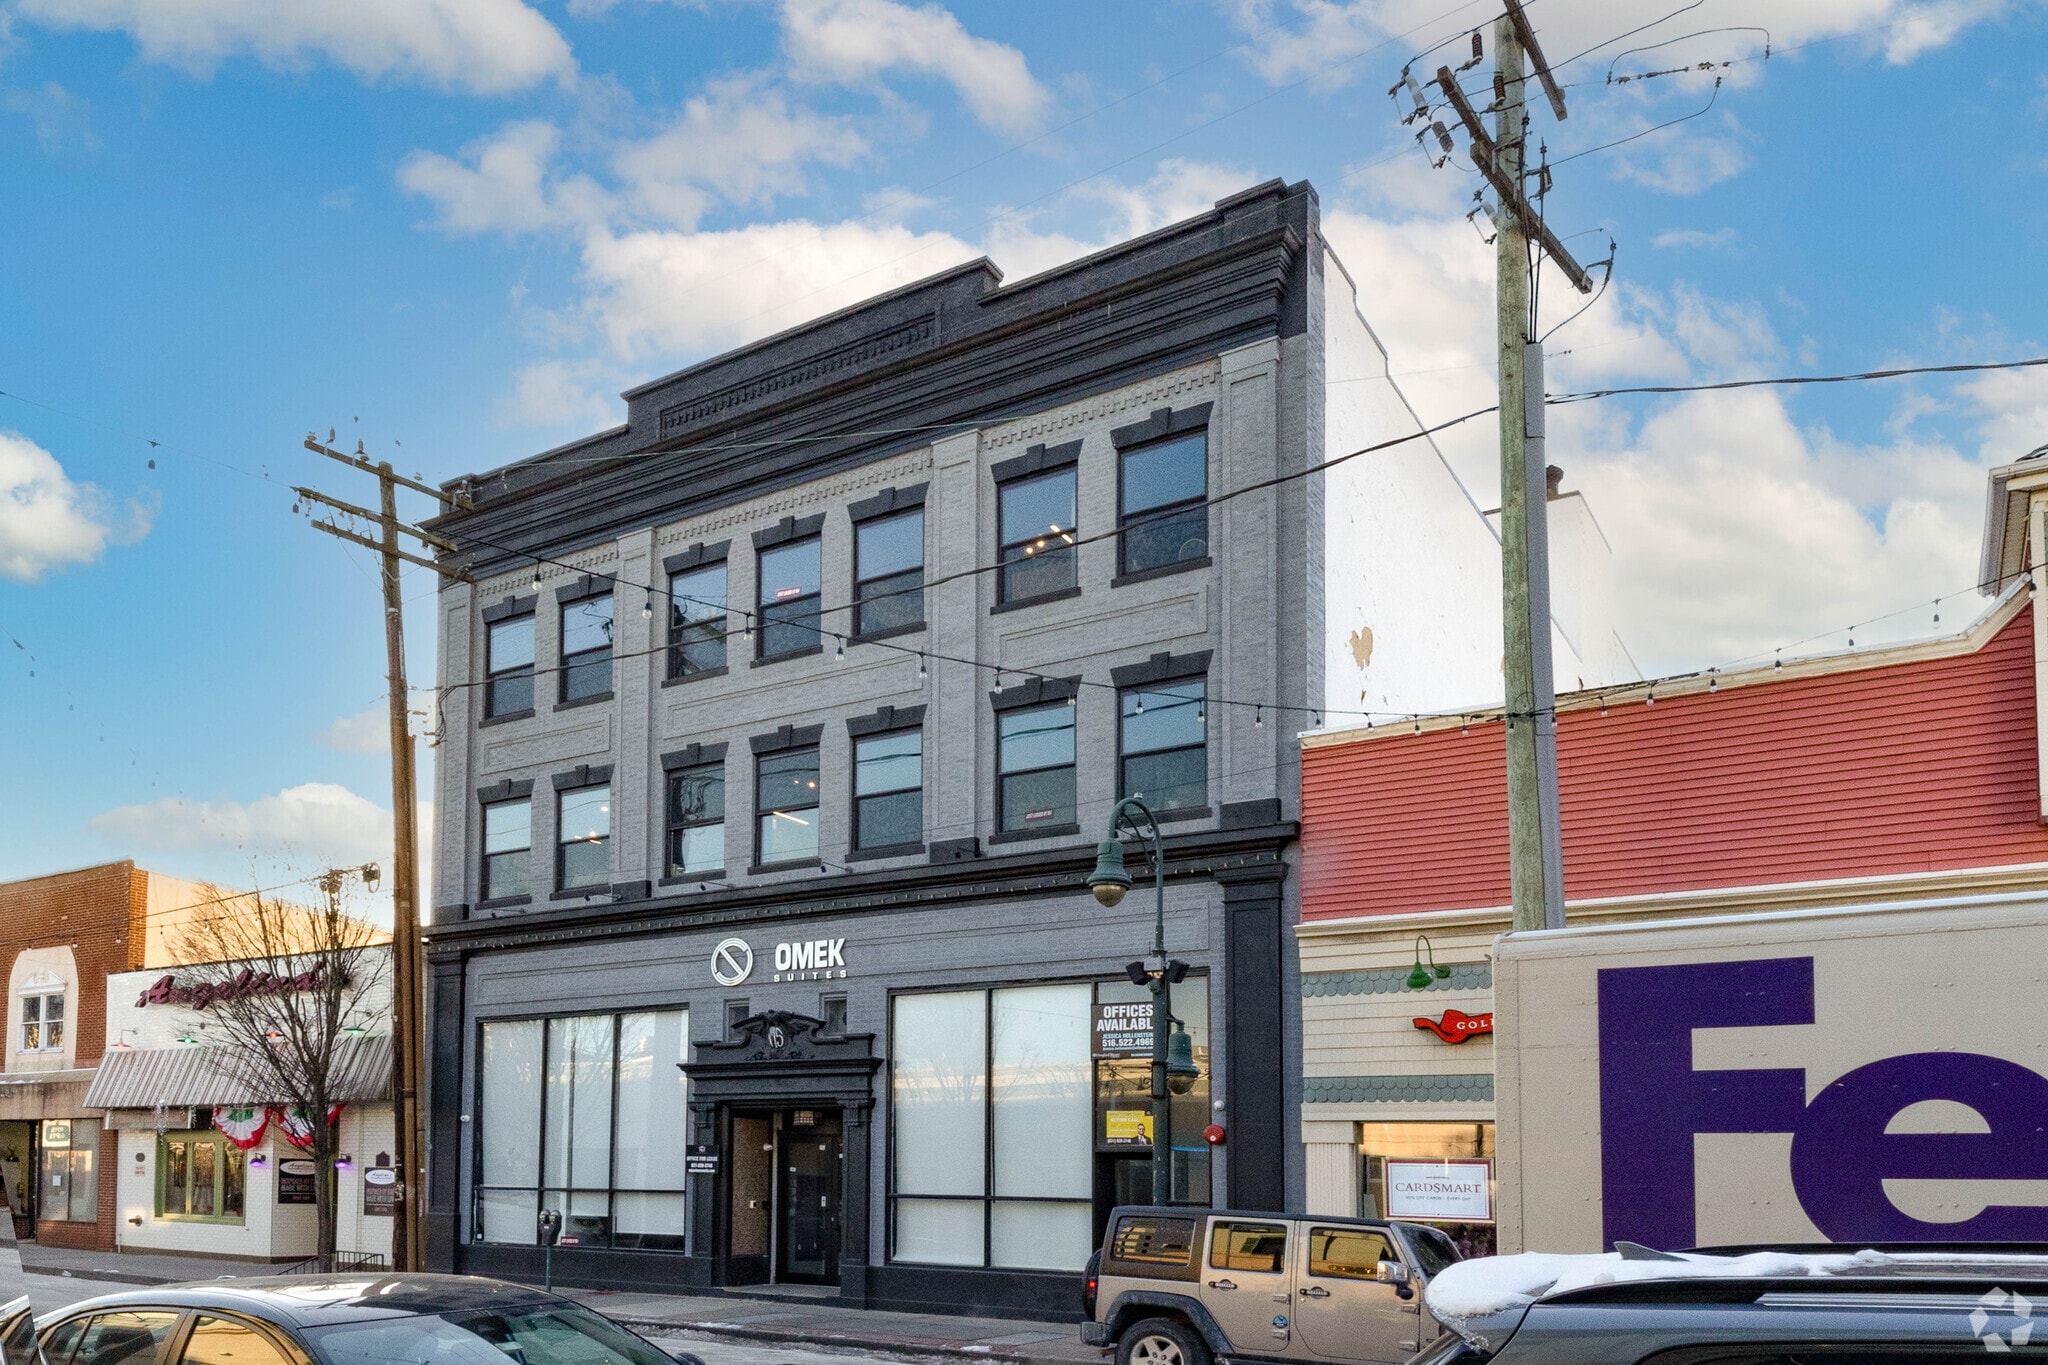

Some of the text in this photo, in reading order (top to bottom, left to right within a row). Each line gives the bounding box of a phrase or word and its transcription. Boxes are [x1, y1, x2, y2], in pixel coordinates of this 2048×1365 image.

[775, 938, 845, 971] OMEK
[773, 970, 847, 983] SUITES
[1103, 1004, 1153, 1018] OFFICES
